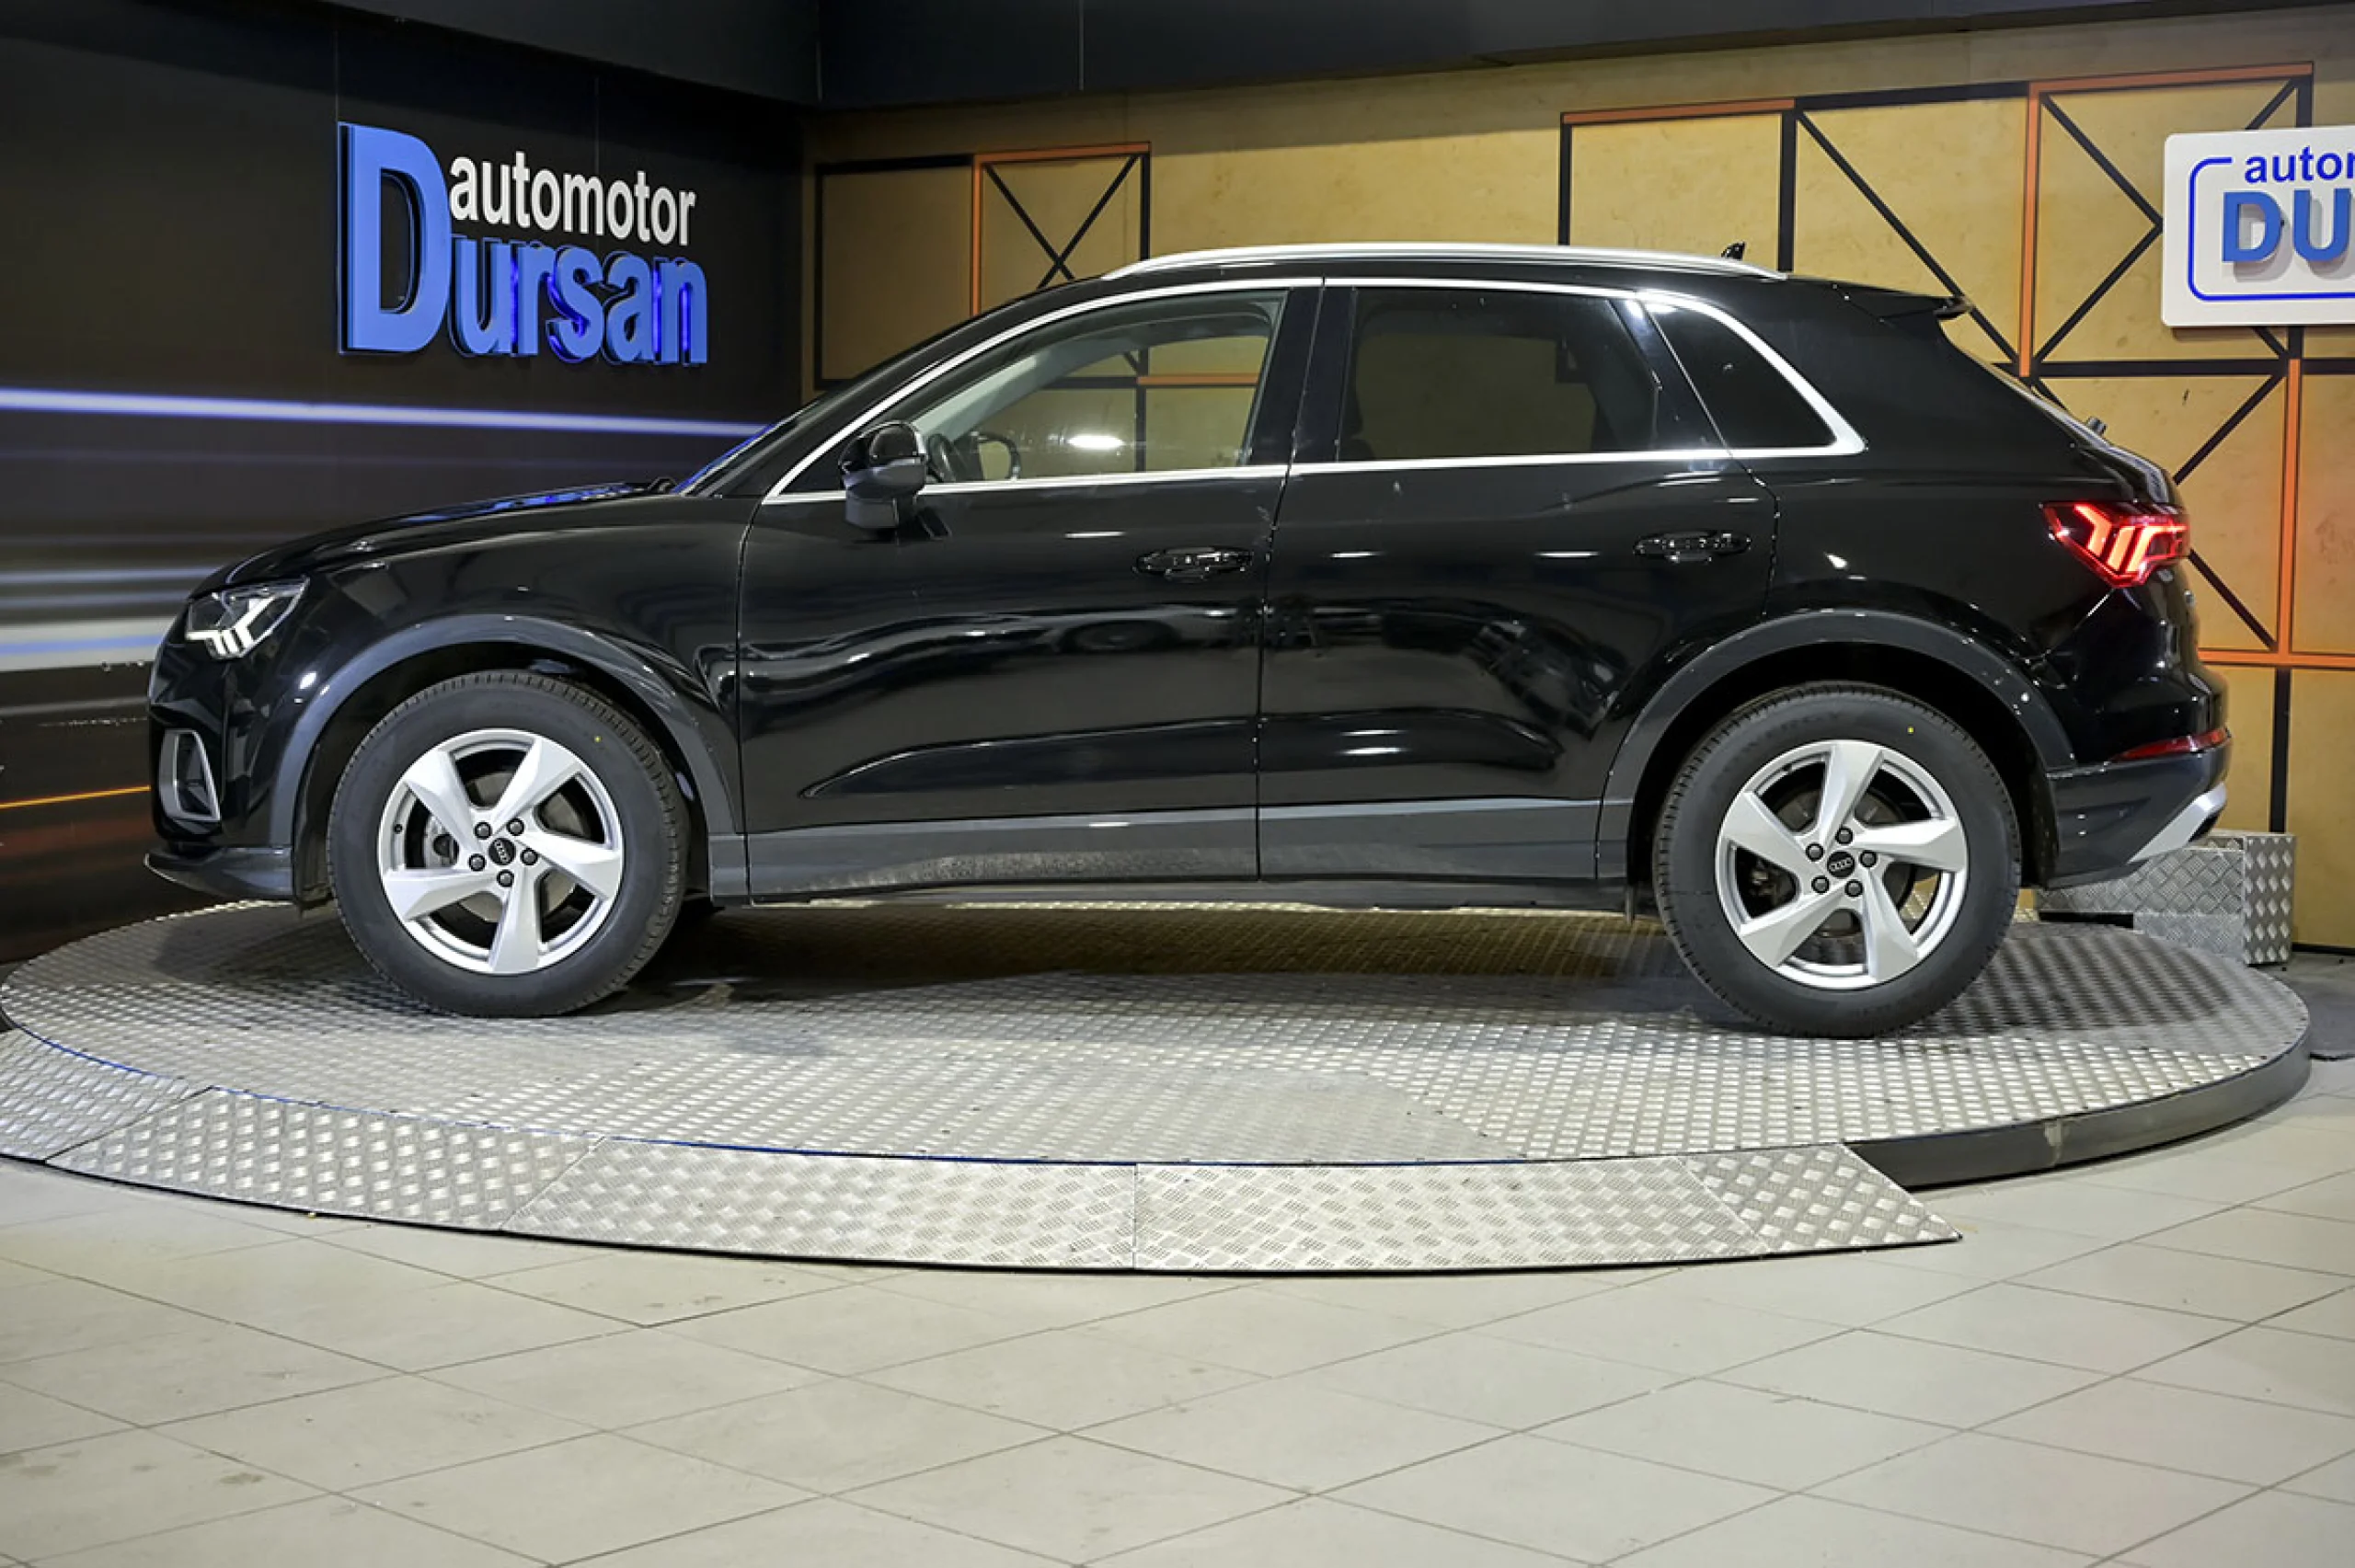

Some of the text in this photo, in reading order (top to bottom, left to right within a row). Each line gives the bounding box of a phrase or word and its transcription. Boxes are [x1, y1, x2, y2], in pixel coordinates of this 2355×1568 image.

[450, 151, 696, 246] automotor
[2245, 145, 2355, 183] auto
[338, 121, 707, 365] Dursan
